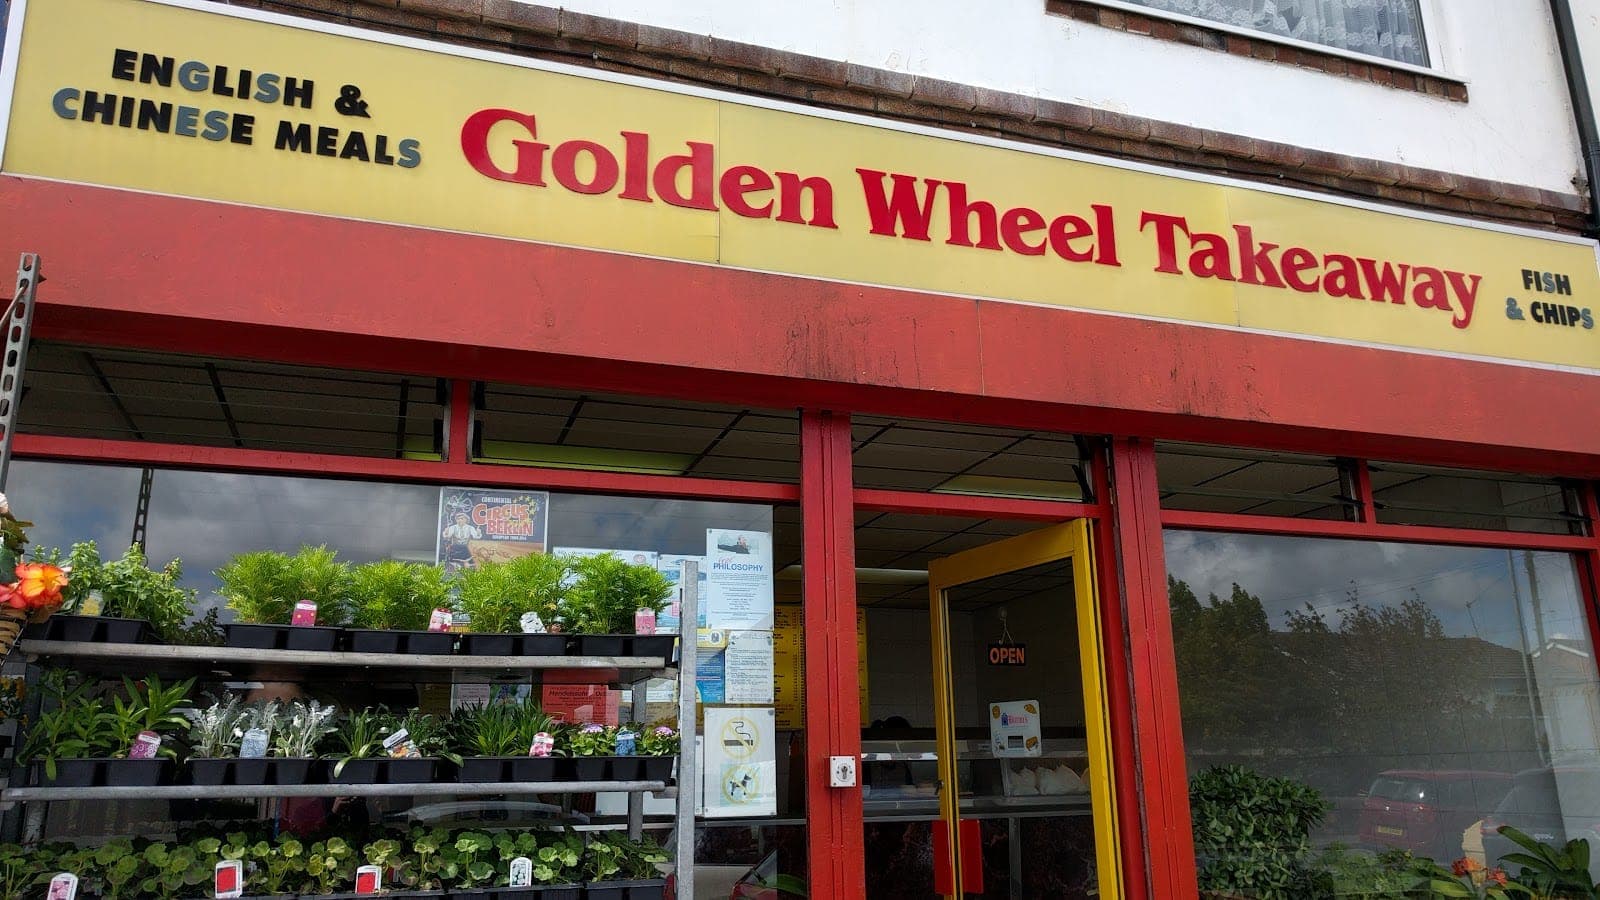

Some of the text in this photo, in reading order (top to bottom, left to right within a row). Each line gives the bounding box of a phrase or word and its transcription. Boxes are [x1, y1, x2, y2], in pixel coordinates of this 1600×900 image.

[111, 47, 372, 119] ENGLISH &
[52, 87, 422, 169] CHINESE MEALS
[460, 108, 1482, 329] Golden Wheel Takeaway
[1521, 268, 1573, 297] FISH
[1506, 297, 1594, 331] & CHIPS
[471, 503, 530, 526] CIRCUS
[486, 519, 534, 536] BERLIN
[713, 562, 764, 572] PHILOSOPHY
[989, 647, 1025, 664] OPEN
